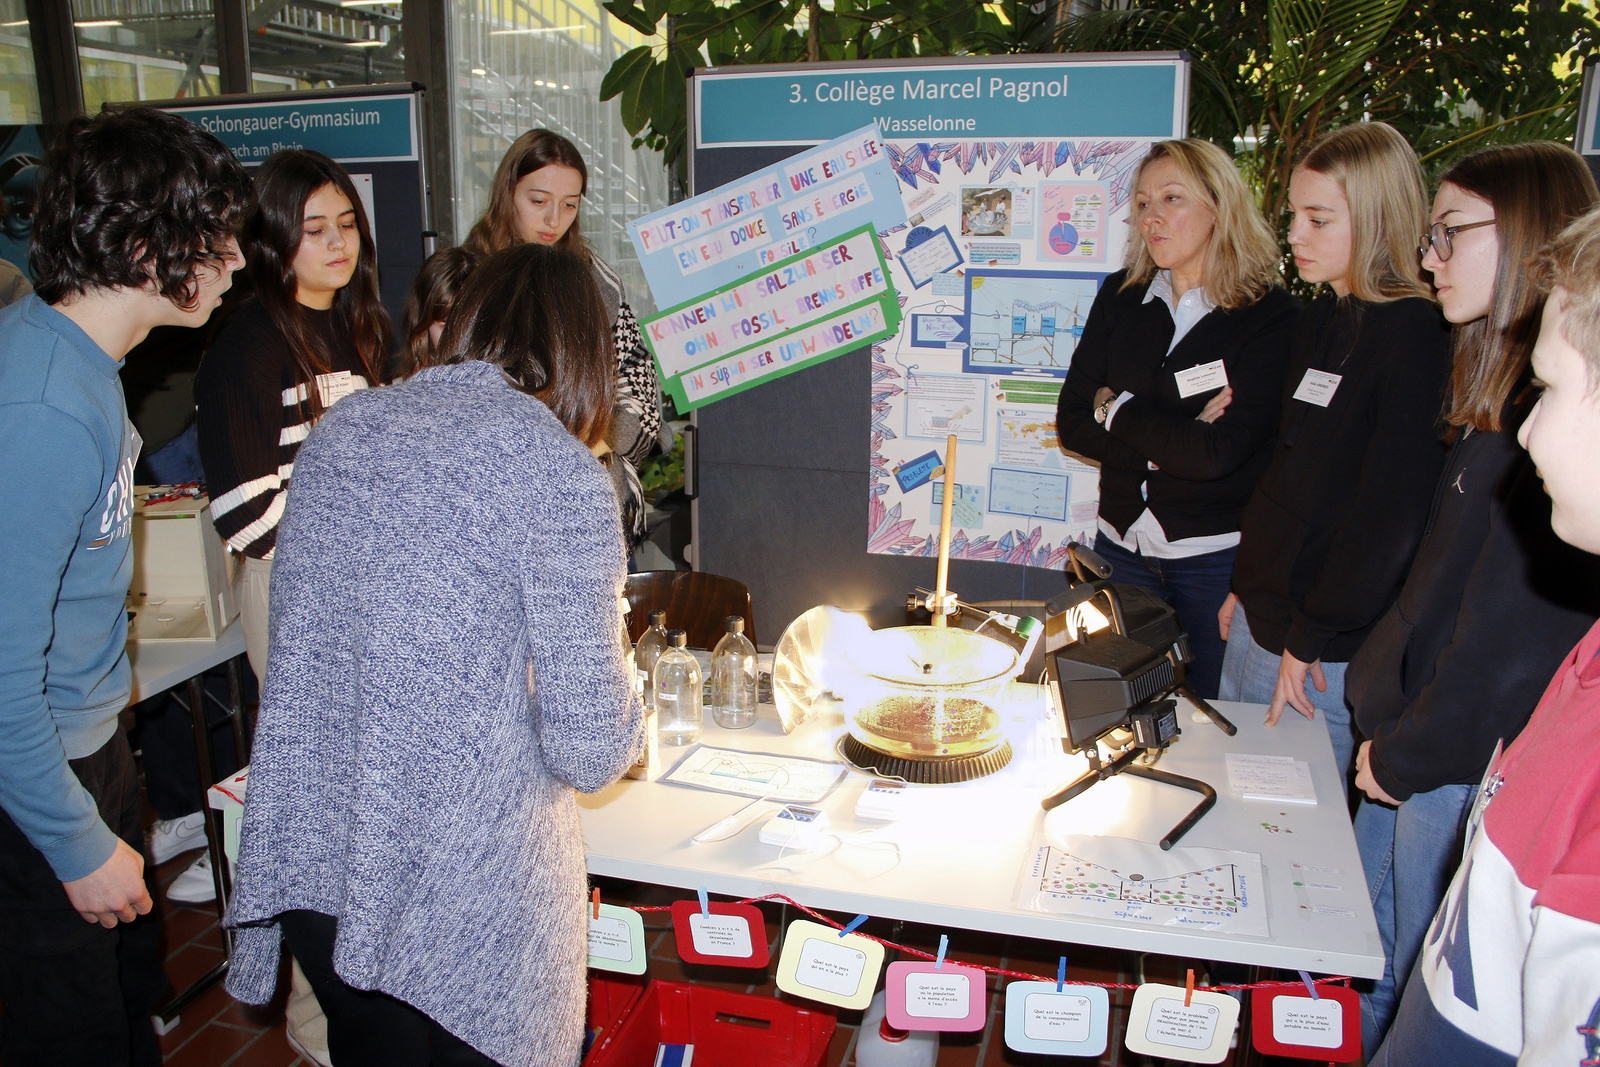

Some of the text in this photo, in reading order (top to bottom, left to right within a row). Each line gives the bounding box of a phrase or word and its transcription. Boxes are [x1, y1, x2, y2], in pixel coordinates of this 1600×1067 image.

[790, 74, 1068, 106] 3. Collège Marcel Pagnol
[200, 108, 380, 135] Schongauer-Gymnasium
[874, 114, 976, 132] Wasselonne
[252, 145, 270, 157] am
[700, 182, 782, 227] TRANSFORMER
[790, 167, 818, 191] UNE
[822, 156, 846, 178] EAU
[678, 248, 698, 269] EN
[700, 239, 724, 261] EAU
[730, 219, 766, 246] DOUCE
[782, 206, 814, 230] SANS
[756, 244, 854, 298] SALZWASSER
[684, 328, 727, 356] OHNE
[796, 266, 883, 314] BRENNSTOFFE
